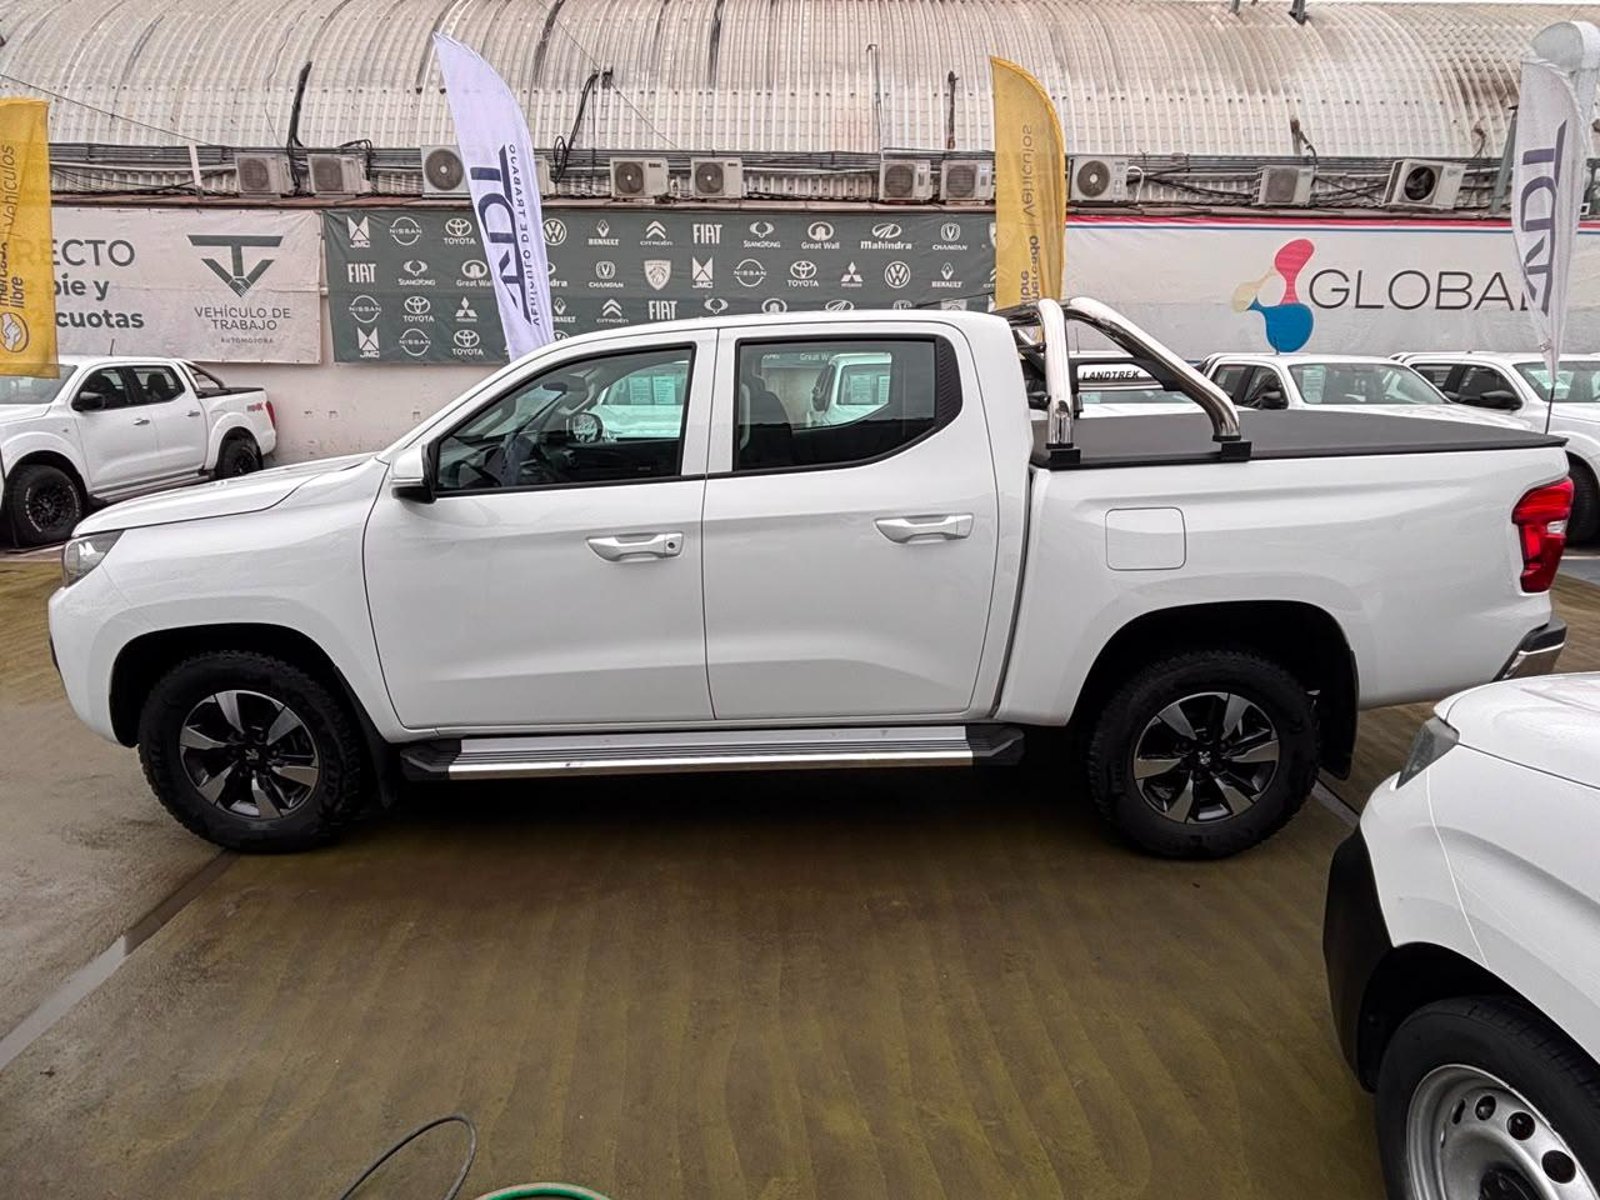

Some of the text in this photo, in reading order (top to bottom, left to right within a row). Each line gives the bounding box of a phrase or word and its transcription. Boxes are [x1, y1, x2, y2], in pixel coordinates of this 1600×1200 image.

[692, 223, 723, 245] FIAT
[350, 240, 371, 248] JMC
[443, 237, 476, 245] TOYOTA
[801, 241, 840, 250] Great Wall
[860, 240, 912, 250] Mahindra
[347, 263, 377, 283] FIAT
[456, 279, 477, 287] Great
[787, 279, 819, 287] TOYOTA
[9, 276, 25, 308] libre
[93, 280, 110, 301] y
[194, 304, 291, 318] VEHÍCULO DE
[648, 300, 678, 320] FIAT
[56, 309, 144, 328] cuotas
[211, 319, 277, 331] TRABAJO
[360, 350, 380, 358] JMC
[452, 348, 484, 356] TOYOTA
[1082, 370, 1140, 381] LANDTREK
